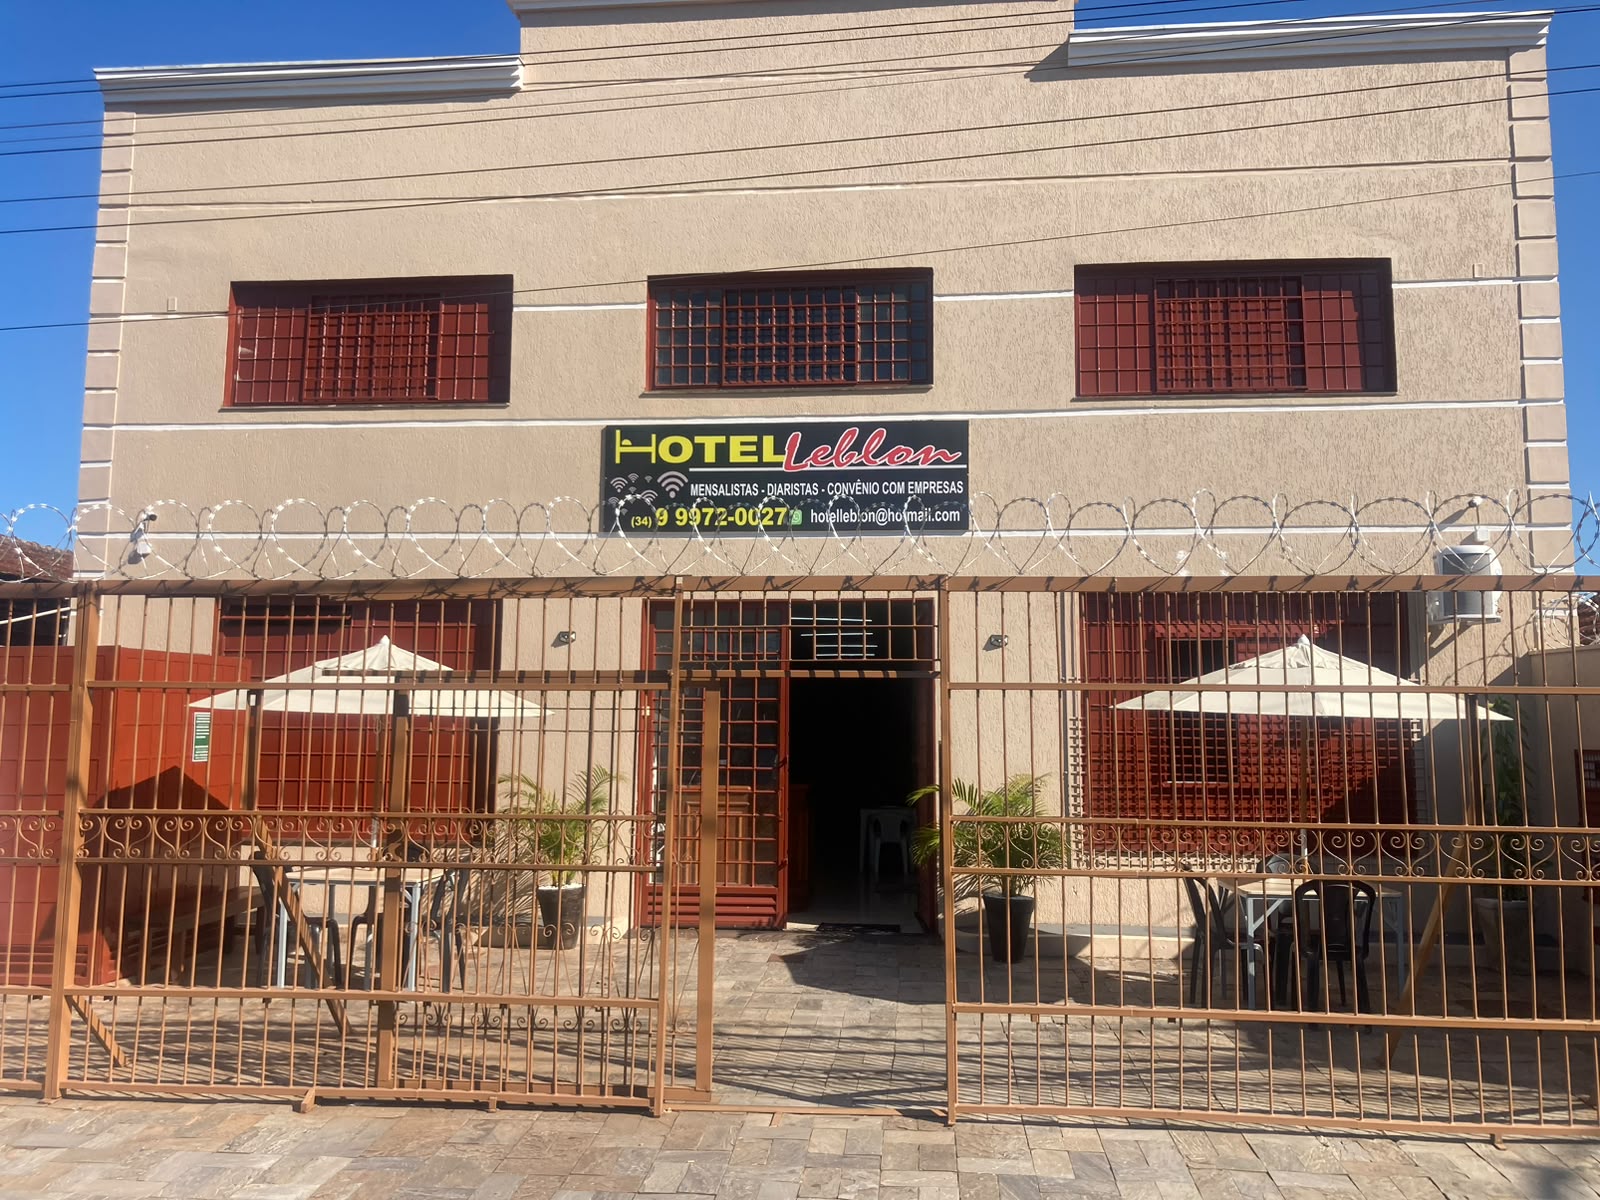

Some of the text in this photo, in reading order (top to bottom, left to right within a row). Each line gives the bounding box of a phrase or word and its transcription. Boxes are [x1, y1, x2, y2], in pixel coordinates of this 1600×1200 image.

[615, 427, 962, 472] HOTEL Leblon
[690, 483, 759, 496] MENSALISTAS
[767, 483, 819, 496] DIARISTAS
[827, 479, 880, 495] CONVÊNIO
[882, 482, 905, 494] COM
[908, 481, 964, 494] EMPRESAS
[631, 516, 652, 528] (34)
[655, 507, 669, 526] 9
[675, 507, 788, 526] 9972-0027
